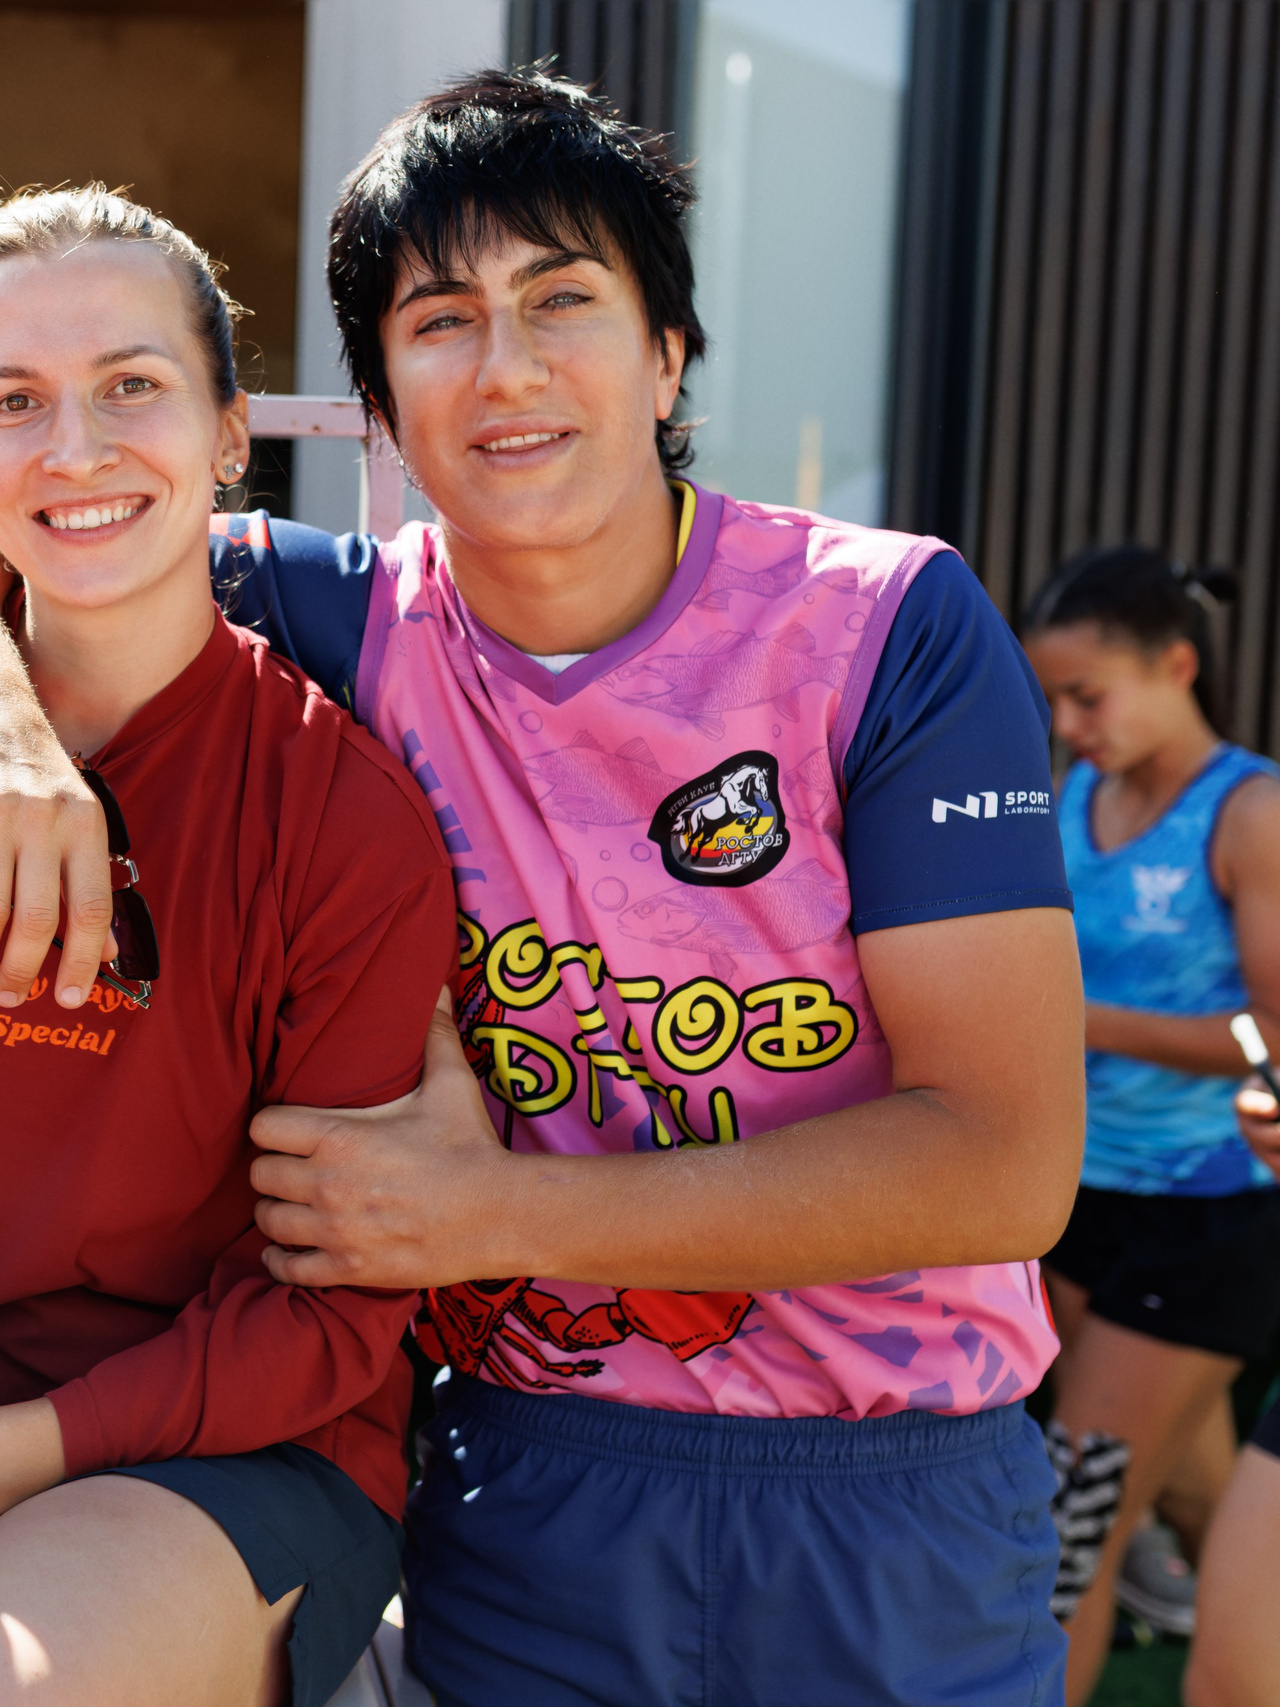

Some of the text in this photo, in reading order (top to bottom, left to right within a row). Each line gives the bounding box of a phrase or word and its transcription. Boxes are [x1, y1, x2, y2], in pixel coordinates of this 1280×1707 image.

[667, 781, 716, 817] РЕГБИ КЛУБ
[1004, 790, 1050, 806] SPORT
[1004, 806, 1050, 815] LABORATORY
[715, 833, 784, 850] РОСТОВ
[717, 850, 762, 867] ДГТУ
